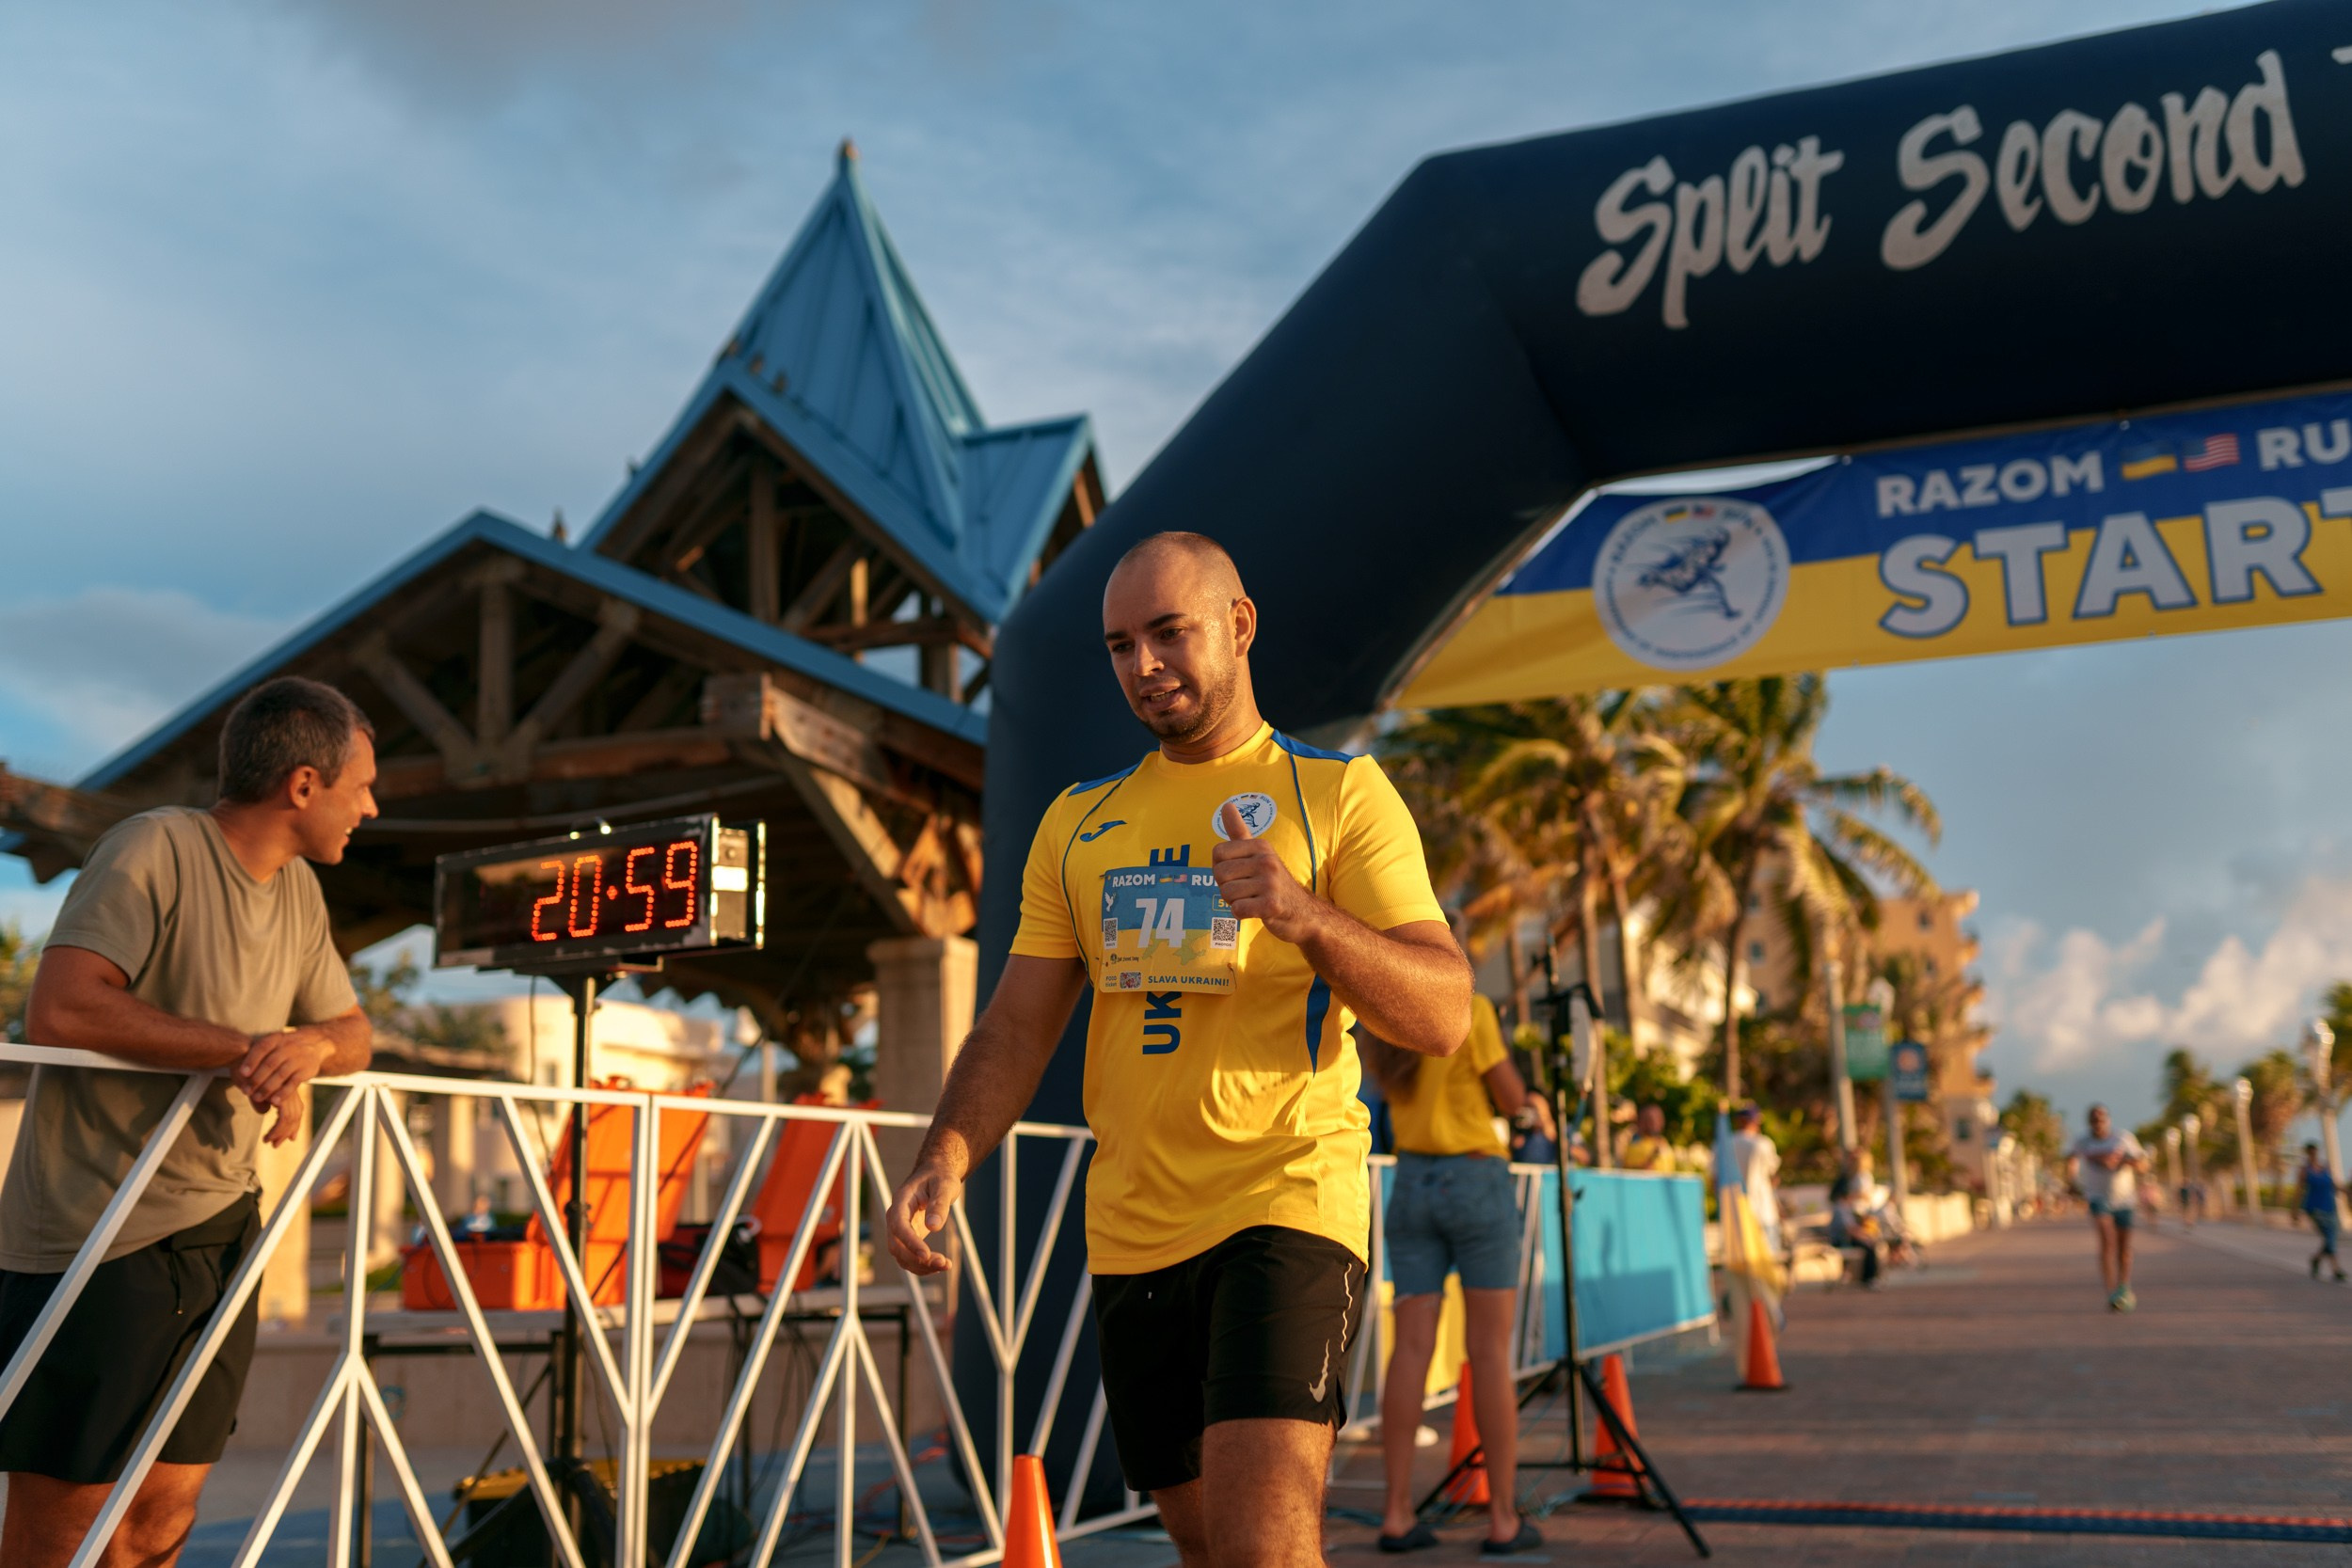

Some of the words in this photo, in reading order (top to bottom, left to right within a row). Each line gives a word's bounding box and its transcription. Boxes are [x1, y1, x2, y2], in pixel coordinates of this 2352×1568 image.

[1577, 136, 1844, 328] Split
[1882, 50, 2305, 270] Second
[1876, 450, 2105, 516] RAZOM
[2256, 418, 2352, 471] RU
[1112, 874, 1155, 887] RAZOM
[1136, 897, 1185, 948] 74
[1148, 975, 1178, 984] SLAVA
[1181, 976, 1230, 987] UKRAINI!
